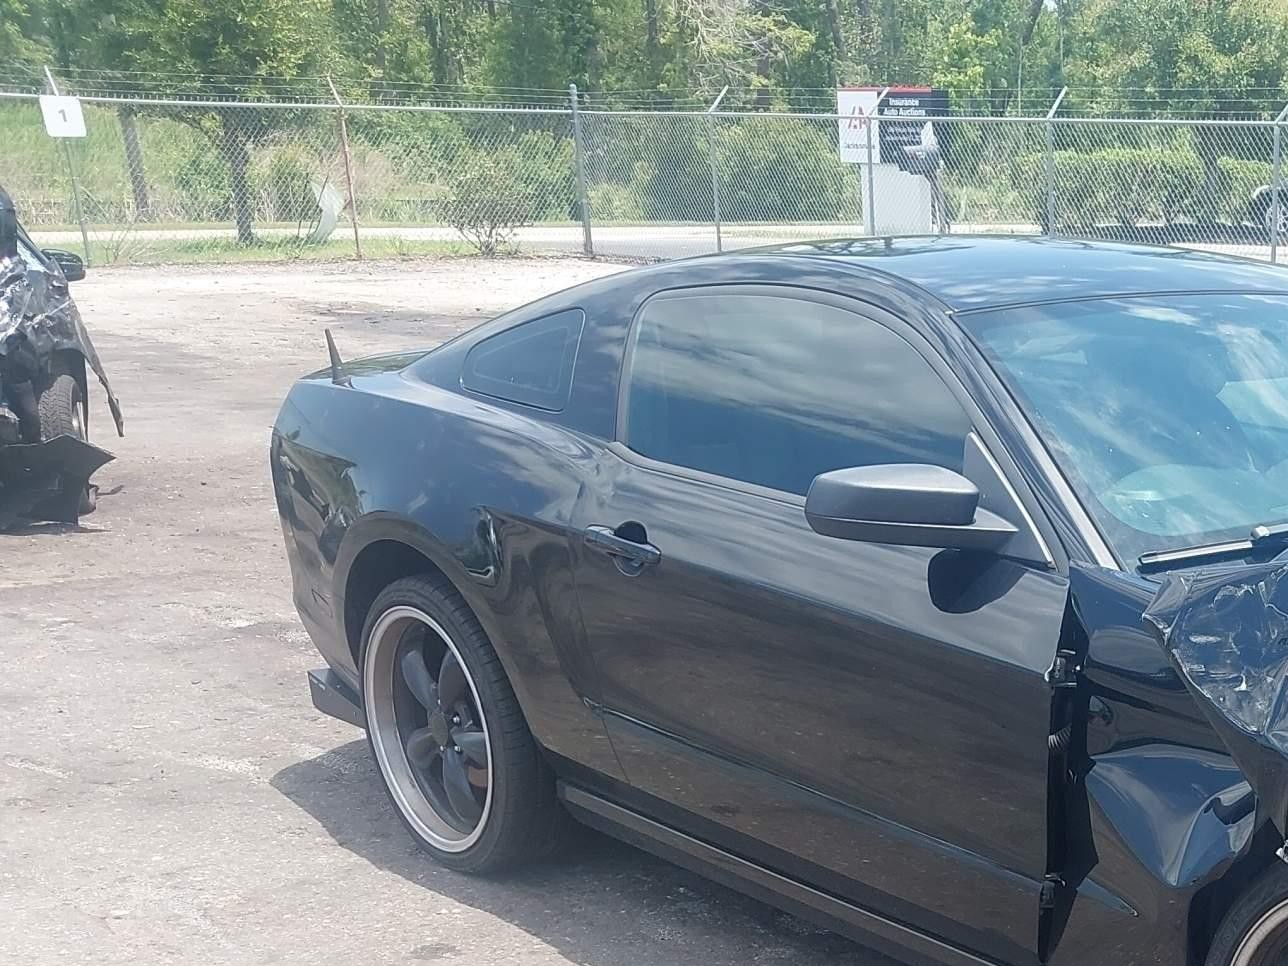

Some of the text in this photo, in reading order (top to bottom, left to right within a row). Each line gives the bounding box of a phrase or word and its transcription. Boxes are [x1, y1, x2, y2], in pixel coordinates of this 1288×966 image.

[889, 98, 919, 106] Insurance
[58, 109, 67, 122] 1
[883, 108, 926, 116] Auto Auctions
